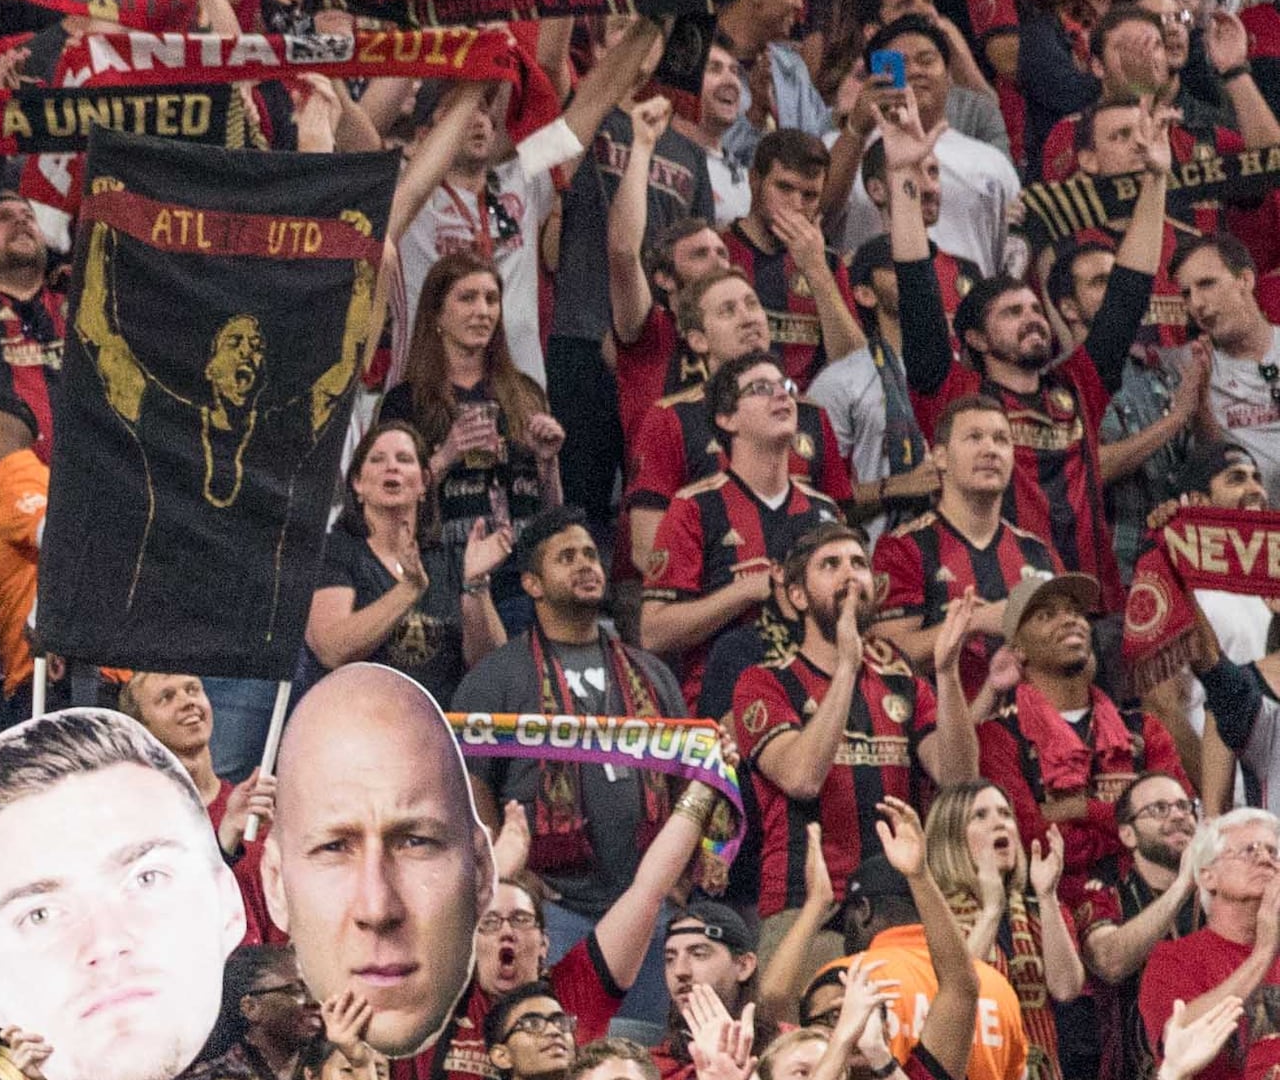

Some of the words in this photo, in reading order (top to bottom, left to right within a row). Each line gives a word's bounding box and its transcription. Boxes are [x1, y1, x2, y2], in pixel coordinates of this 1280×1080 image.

[358, 28, 478, 70] 2017
[44, 92, 213, 138] UNITED
[151, 210, 212, 249] ATL
[267, 219, 324, 256] UTD
